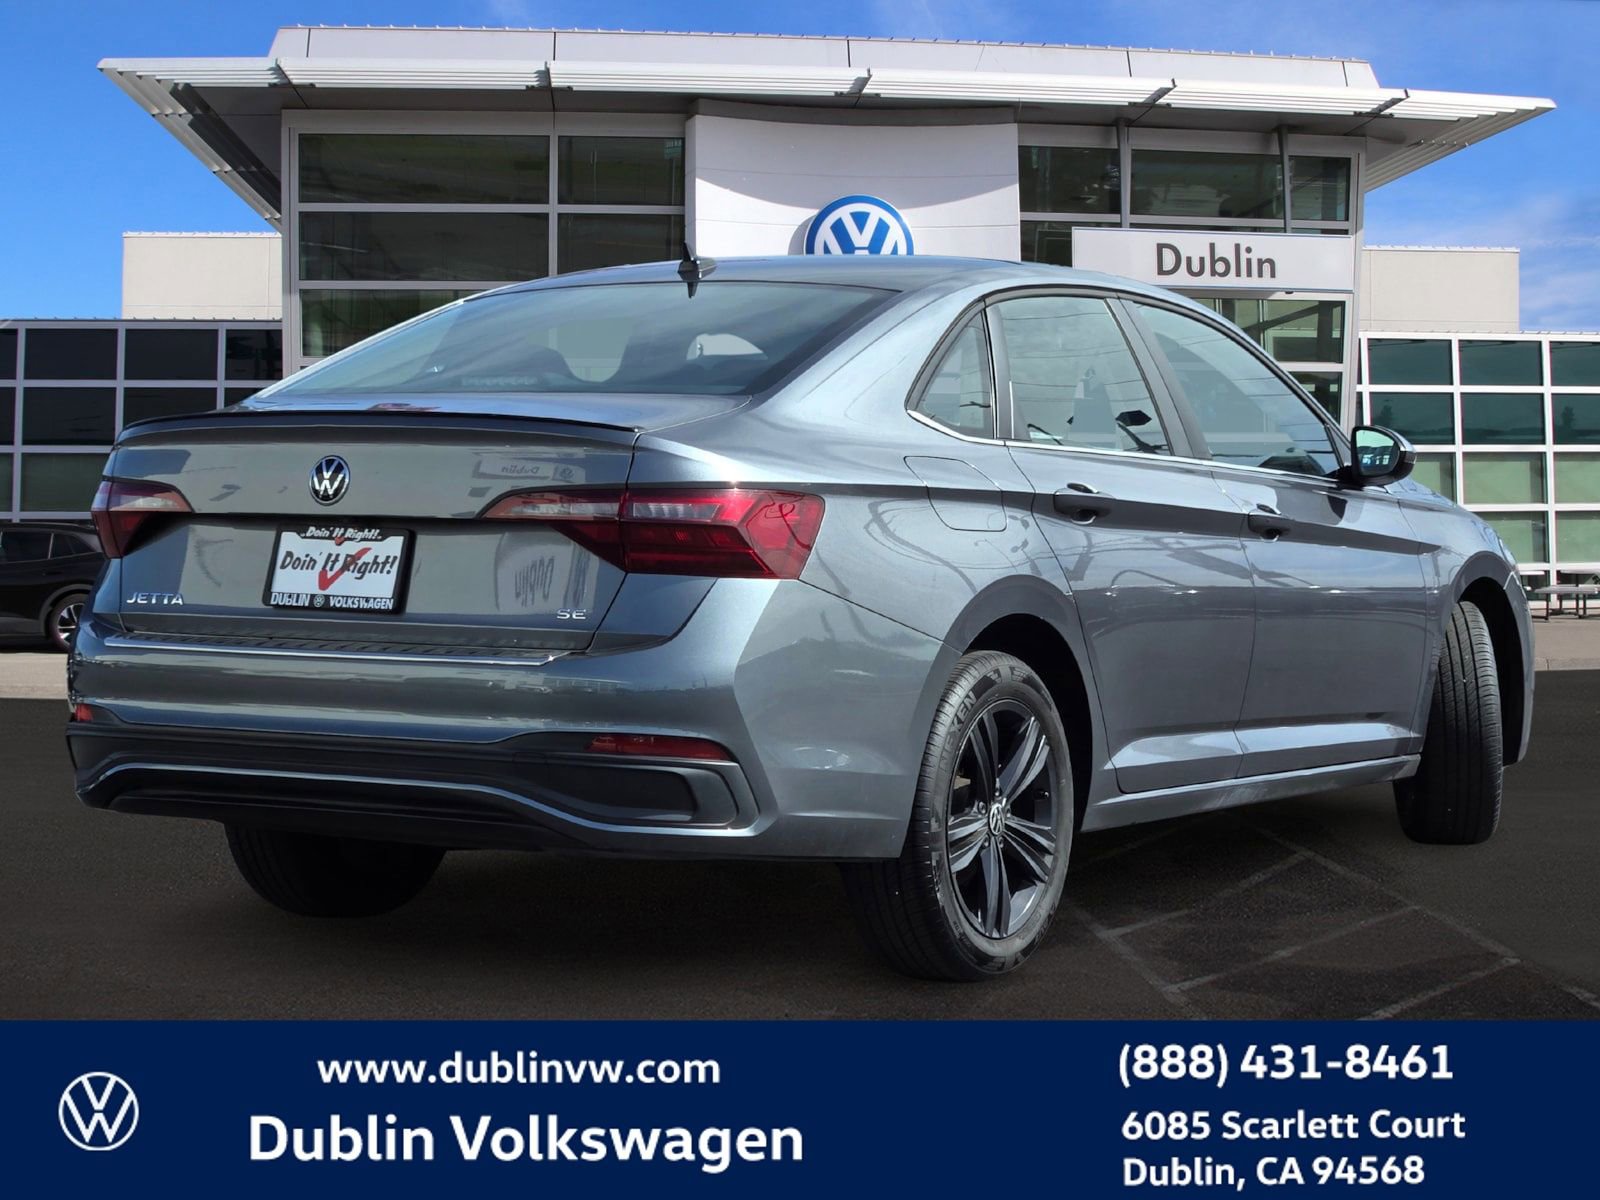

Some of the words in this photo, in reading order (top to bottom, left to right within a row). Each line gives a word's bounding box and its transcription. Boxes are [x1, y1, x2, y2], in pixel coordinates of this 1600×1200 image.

[1156, 242, 1276, 279] Dublin
[311, 457, 348, 503] VW
[332, 527, 344, 538] It
[279, 551, 322, 571] Doin'
[323, 553, 340, 572] It
[342, 554, 398, 580] Right!
[126, 592, 184, 605] JETTA
[270, 592, 311, 607] DUBLIN
[329, 595, 394, 610] VOLKSWAGEN
[556, 609, 587, 620] SE
[939, 690, 978, 772] NEXEN
